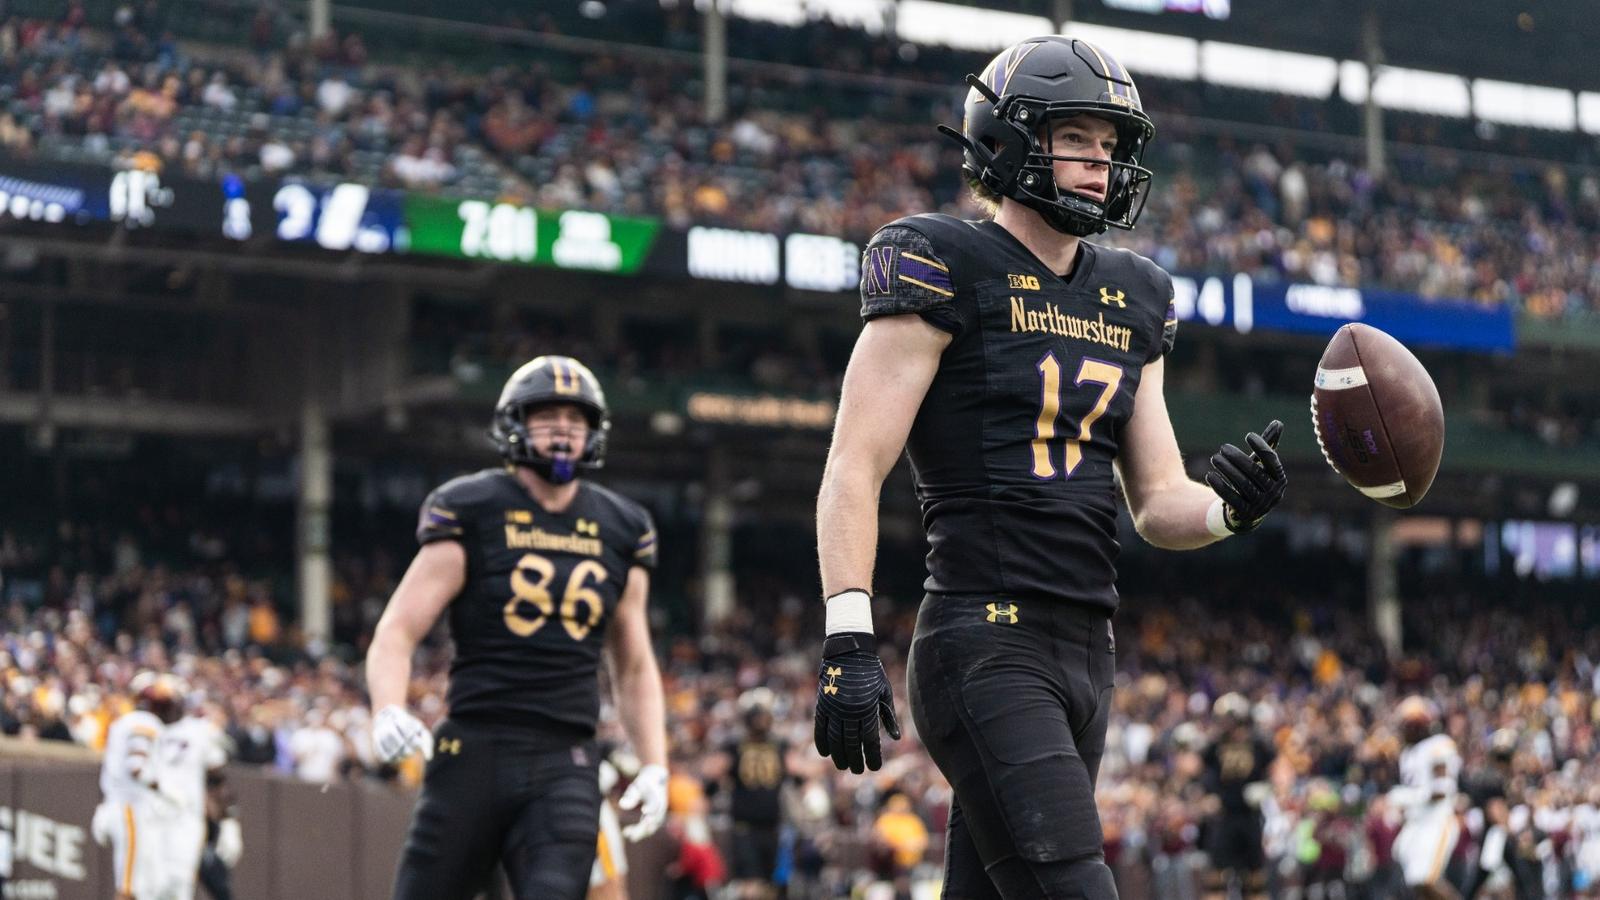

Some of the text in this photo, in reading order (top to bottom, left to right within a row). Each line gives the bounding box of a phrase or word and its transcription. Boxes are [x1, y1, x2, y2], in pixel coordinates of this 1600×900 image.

[867, 246, 893, 295] N
[1009, 296, 1133, 352] Northwestern
[1031, 350, 1124, 481] 17
[504, 524, 603, 556] Northwestern
[503, 553, 608, 641] 86
